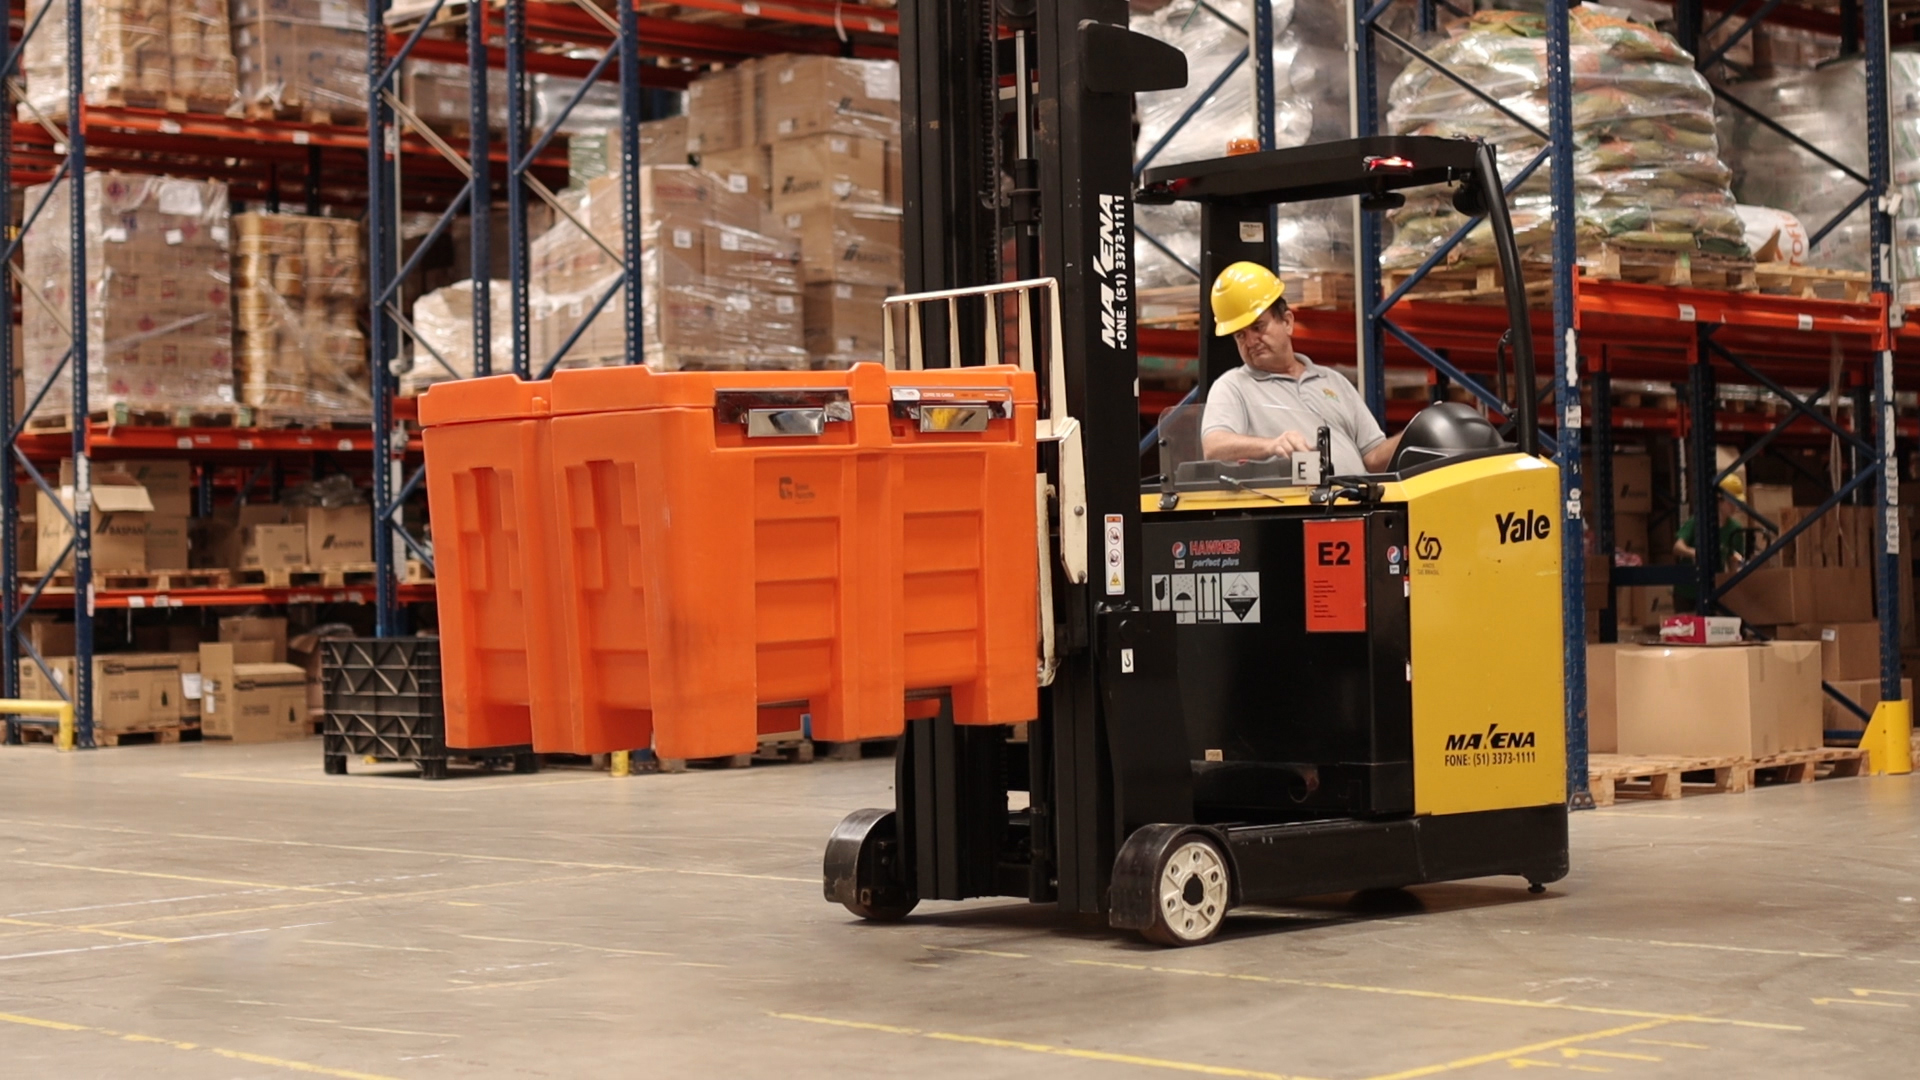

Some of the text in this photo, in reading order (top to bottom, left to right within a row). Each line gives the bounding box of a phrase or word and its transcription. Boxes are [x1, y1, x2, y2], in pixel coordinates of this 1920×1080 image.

[1114, 196, 1125, 270] 3373-1111
[1092, 193, 1116, 350] MAKENA
[1115, 273, 1128, 302] (51)
[1297, 461, 1307, 480] E
[1495, 509, 1551, 545] Yale
[1189, 539, 1241, 556] HAWKER
[1318, 541, 1351, 566] E2
[1192, 557, 1221, 569] perfect
[1221, 556, 1240, 568] plus
[1445, 723, 1535, 751] MAKENA
[1445, 751, 1536, 767] FONE: (51) 3373-1111
